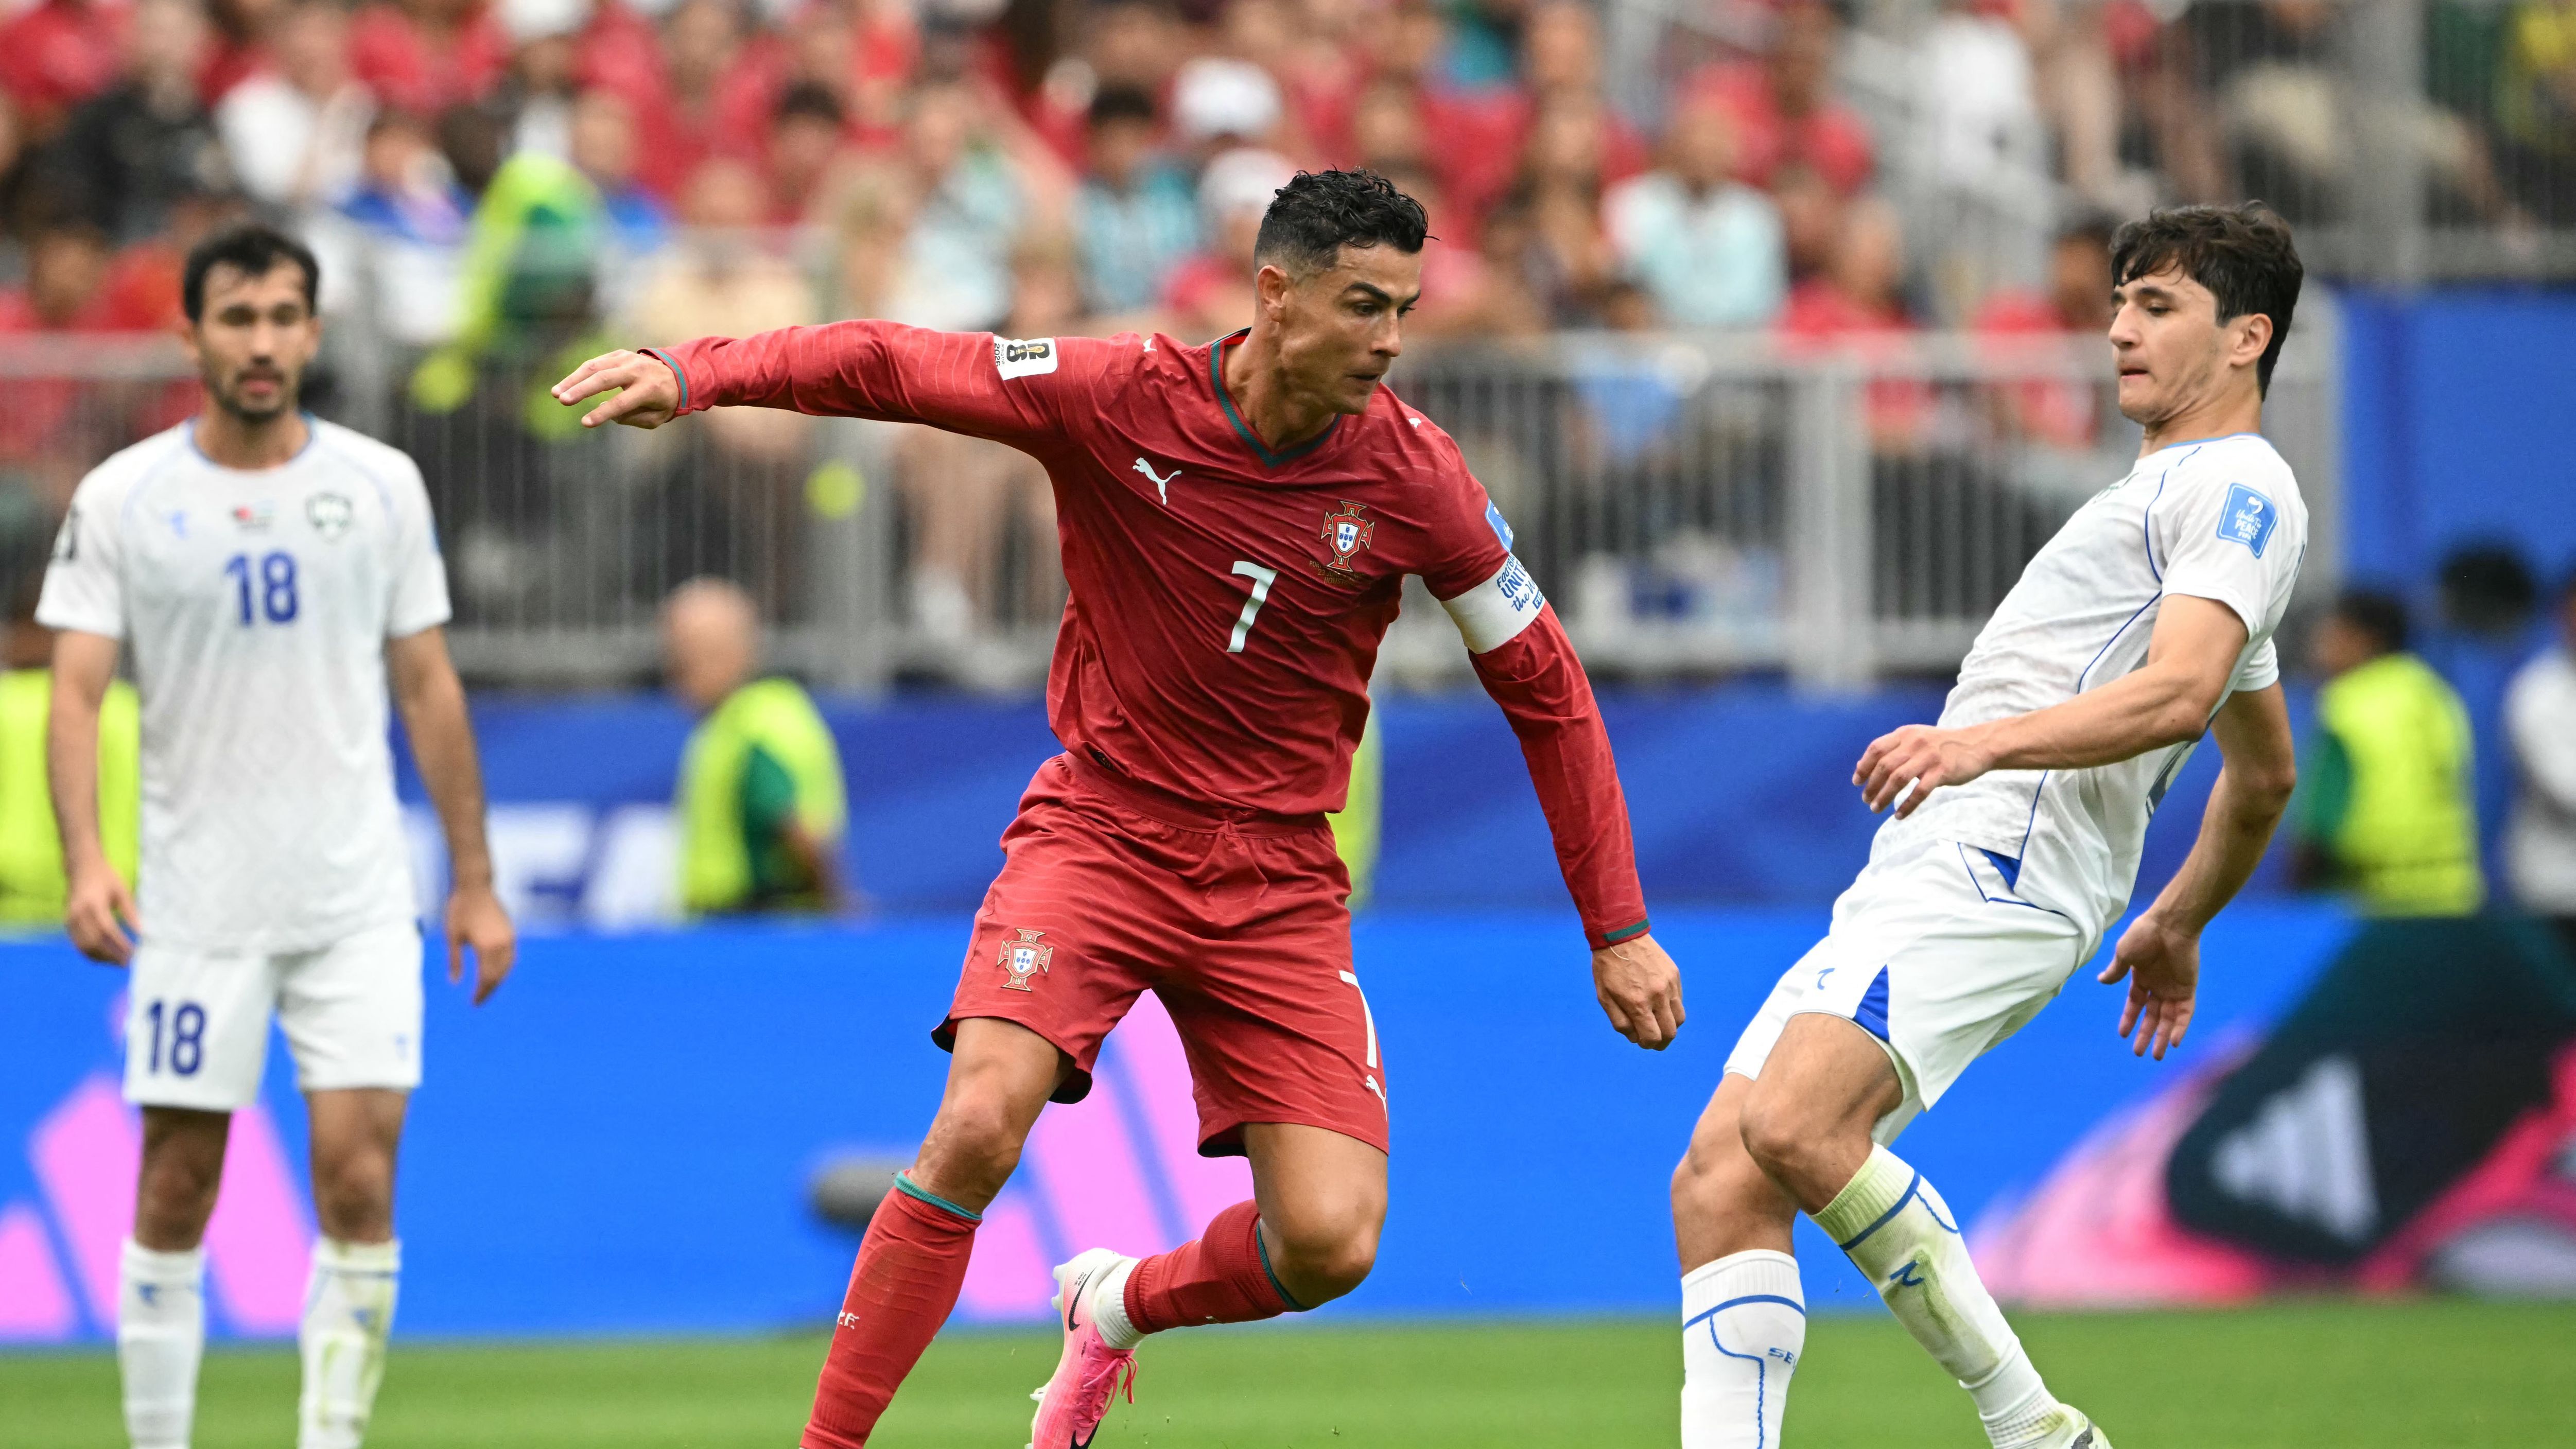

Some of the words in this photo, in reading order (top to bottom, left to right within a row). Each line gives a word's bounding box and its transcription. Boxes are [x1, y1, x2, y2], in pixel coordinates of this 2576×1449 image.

[2235, 519, 2258, 539] PEACE
[224, 552, 299, 626] 18
[1227, 561, 1279, 653] 7
[1511, 596, 1529, 612] the
[148, 1002, 205, 1076] 18
[1338, 970, 1377, 1069] 7
